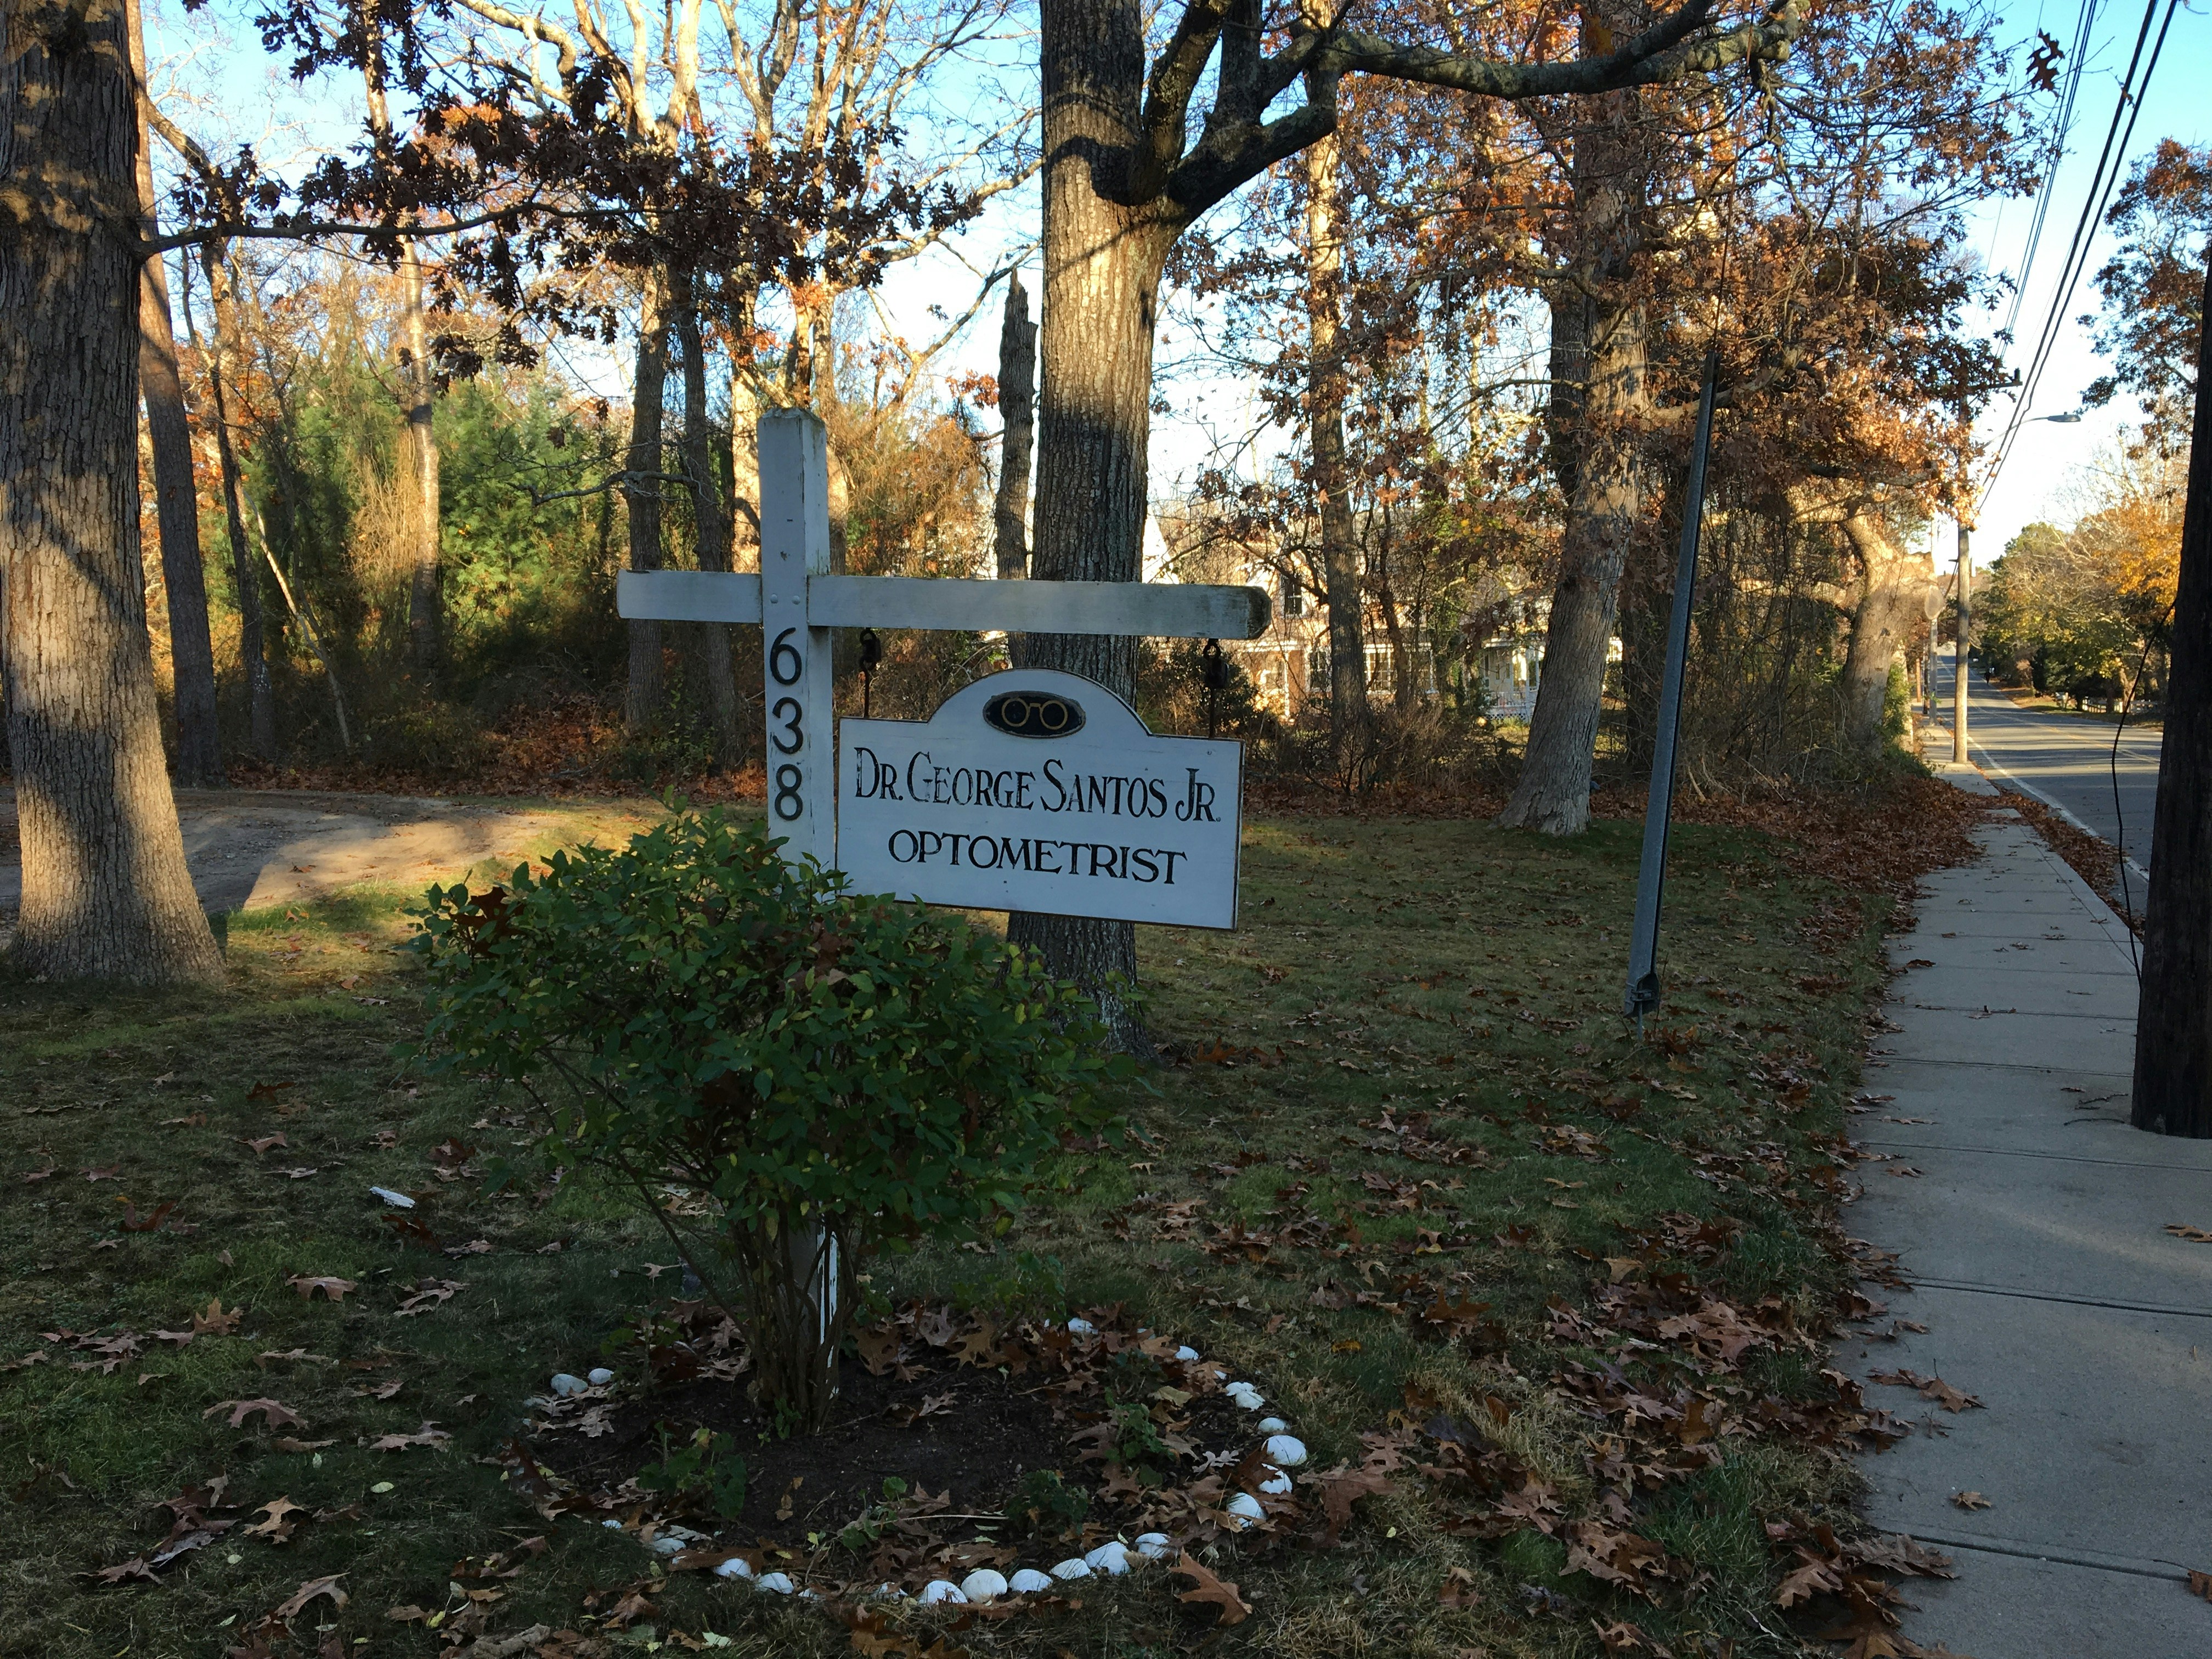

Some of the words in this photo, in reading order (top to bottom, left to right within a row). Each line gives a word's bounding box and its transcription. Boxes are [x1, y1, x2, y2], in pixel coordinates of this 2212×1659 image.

[770, 627, 803, 821] 638
[907, 751, 1035, 810] GEORGE
[1040, 759, 1167, 818] SANTOS
[888, 829, 1188, 884] OPTOMETRIST
